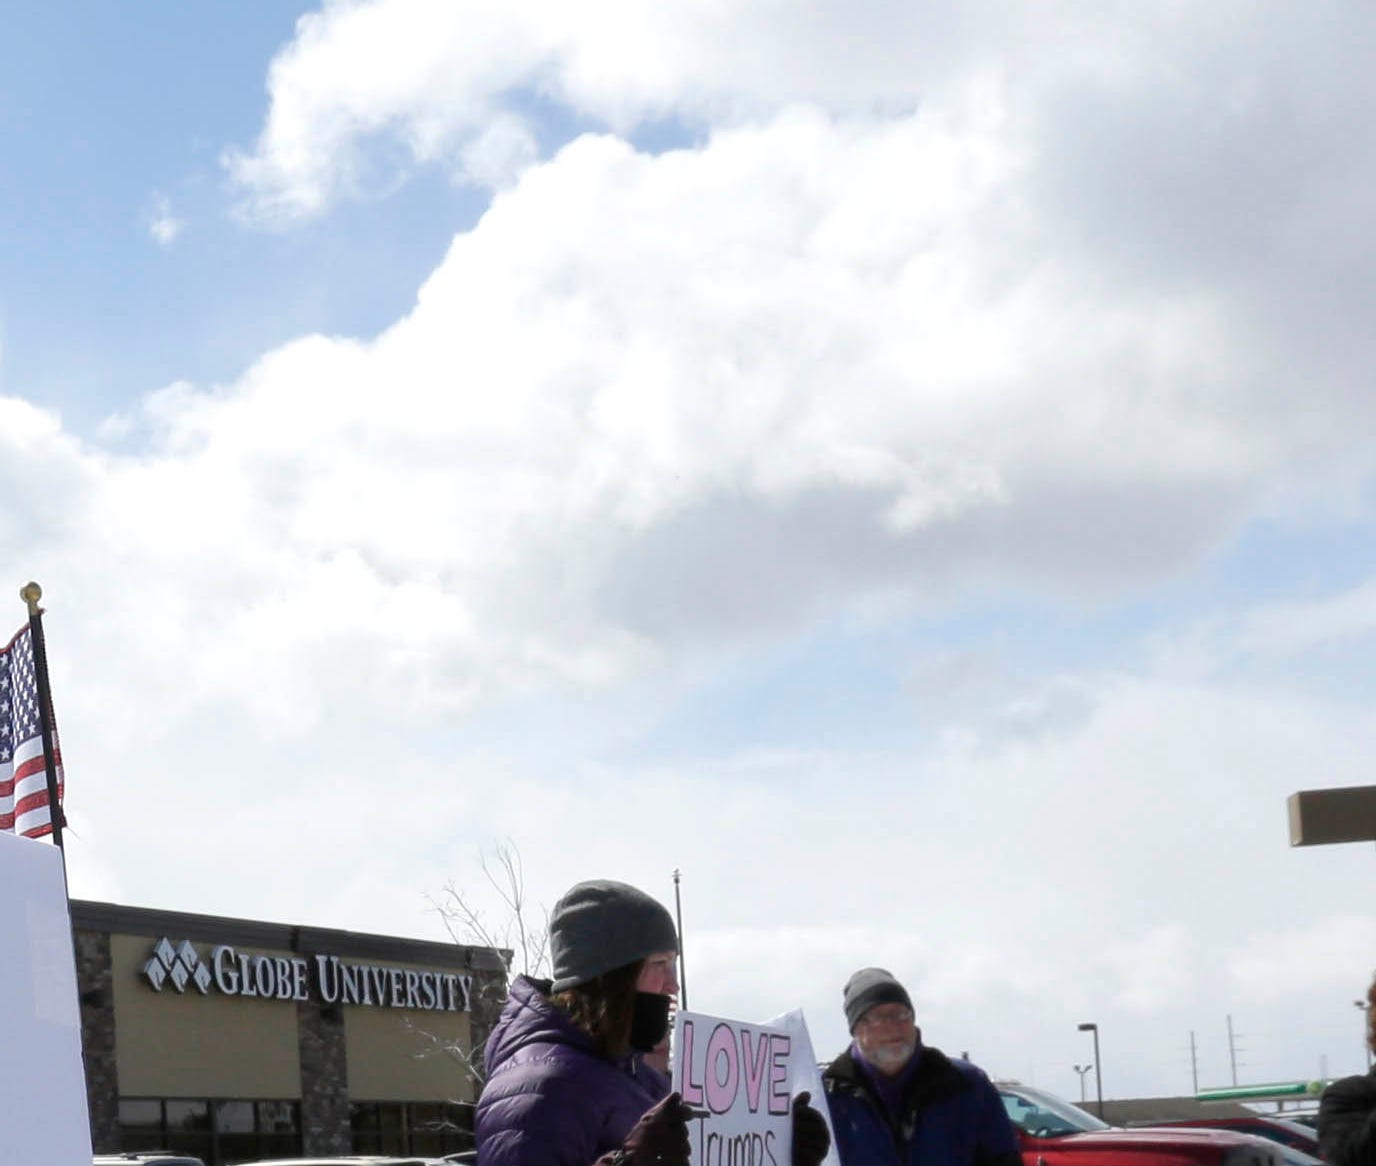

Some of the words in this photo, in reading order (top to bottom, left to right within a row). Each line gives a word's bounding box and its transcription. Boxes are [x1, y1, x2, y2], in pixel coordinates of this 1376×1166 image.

[212, 944, 309, 1001] GLOBE
[315, 954, 473, 1012] UNIVERSITY
[681, 1020, 791, 1116] LOVE
